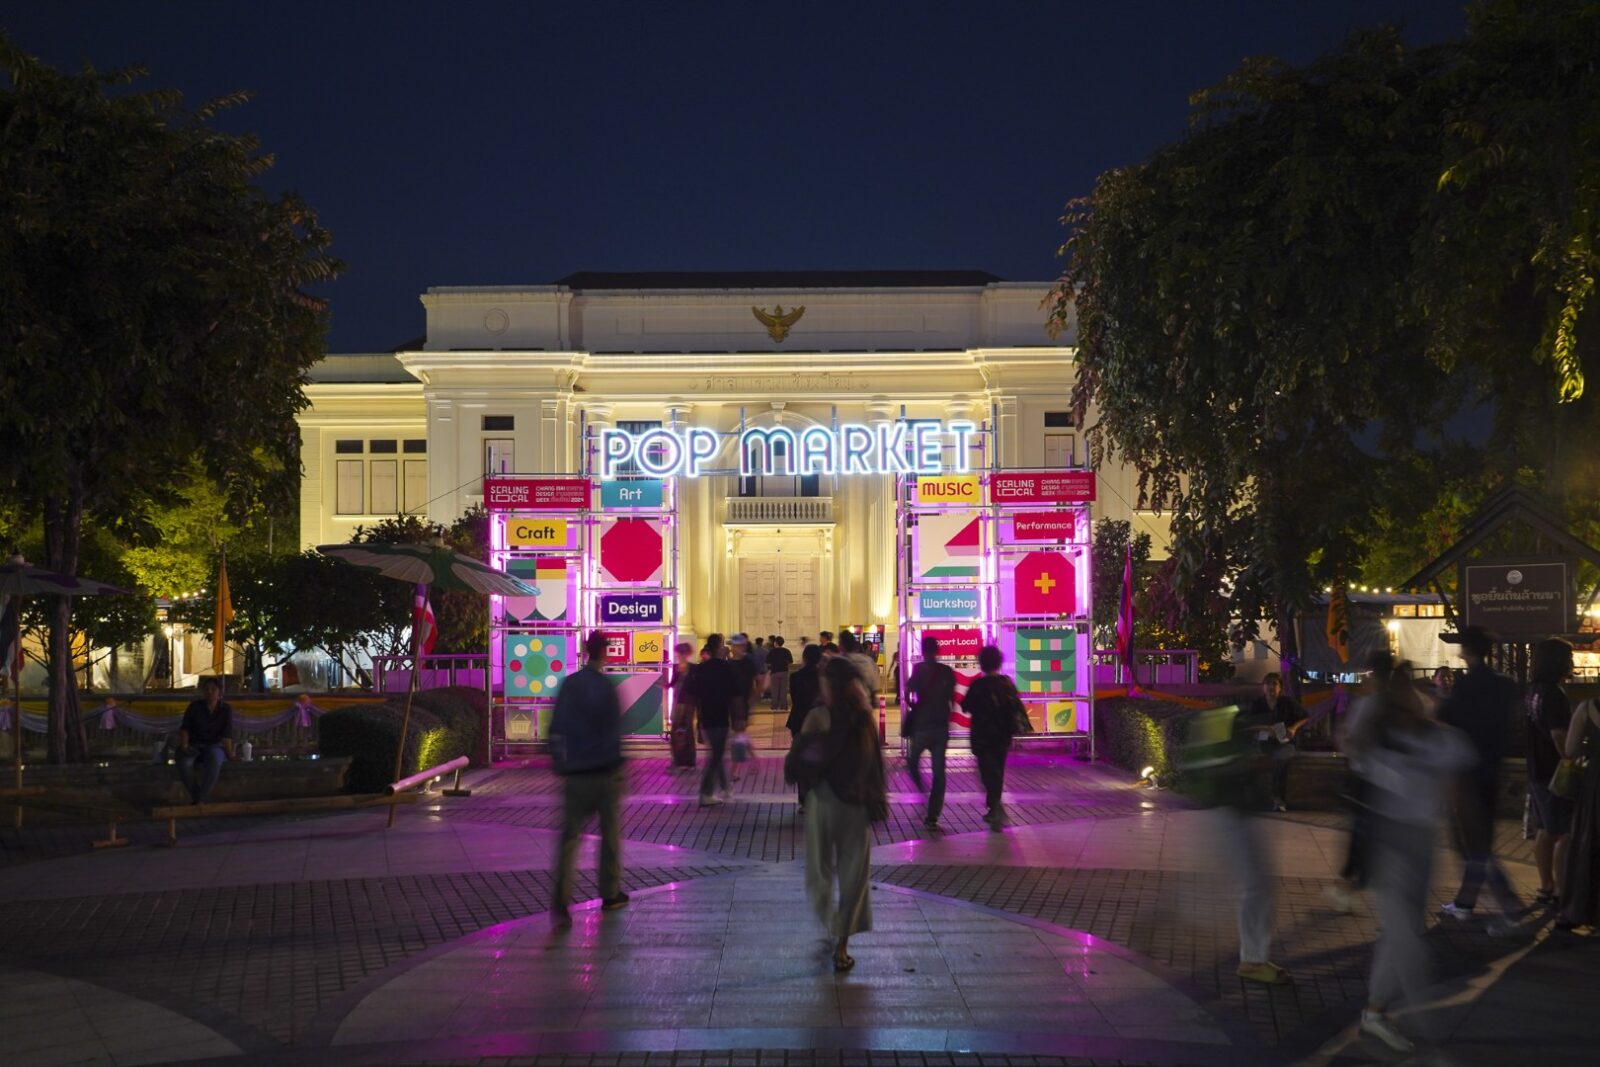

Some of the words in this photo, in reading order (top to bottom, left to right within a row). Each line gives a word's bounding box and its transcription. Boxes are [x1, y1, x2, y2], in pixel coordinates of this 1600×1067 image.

[600, 426, 718, 480] POP
[739, 423, 975, 477] MARKET
[490, 486, 529, 494] SCALING
[921, 482, 973, 496] MUSIC
[997, 480, 1035, 489] SCALING
[490, 494, 529, 503] LOCAL
[619, 488, 642, 501] Art
[997, 488, 1036, 497] LOCAL
[1016, 520, 1072, 531] Performance
[516, 525, 555, 540] Craft
[608, 602, 657, 617] Design
[922, 598, 977, 610] Workshop
